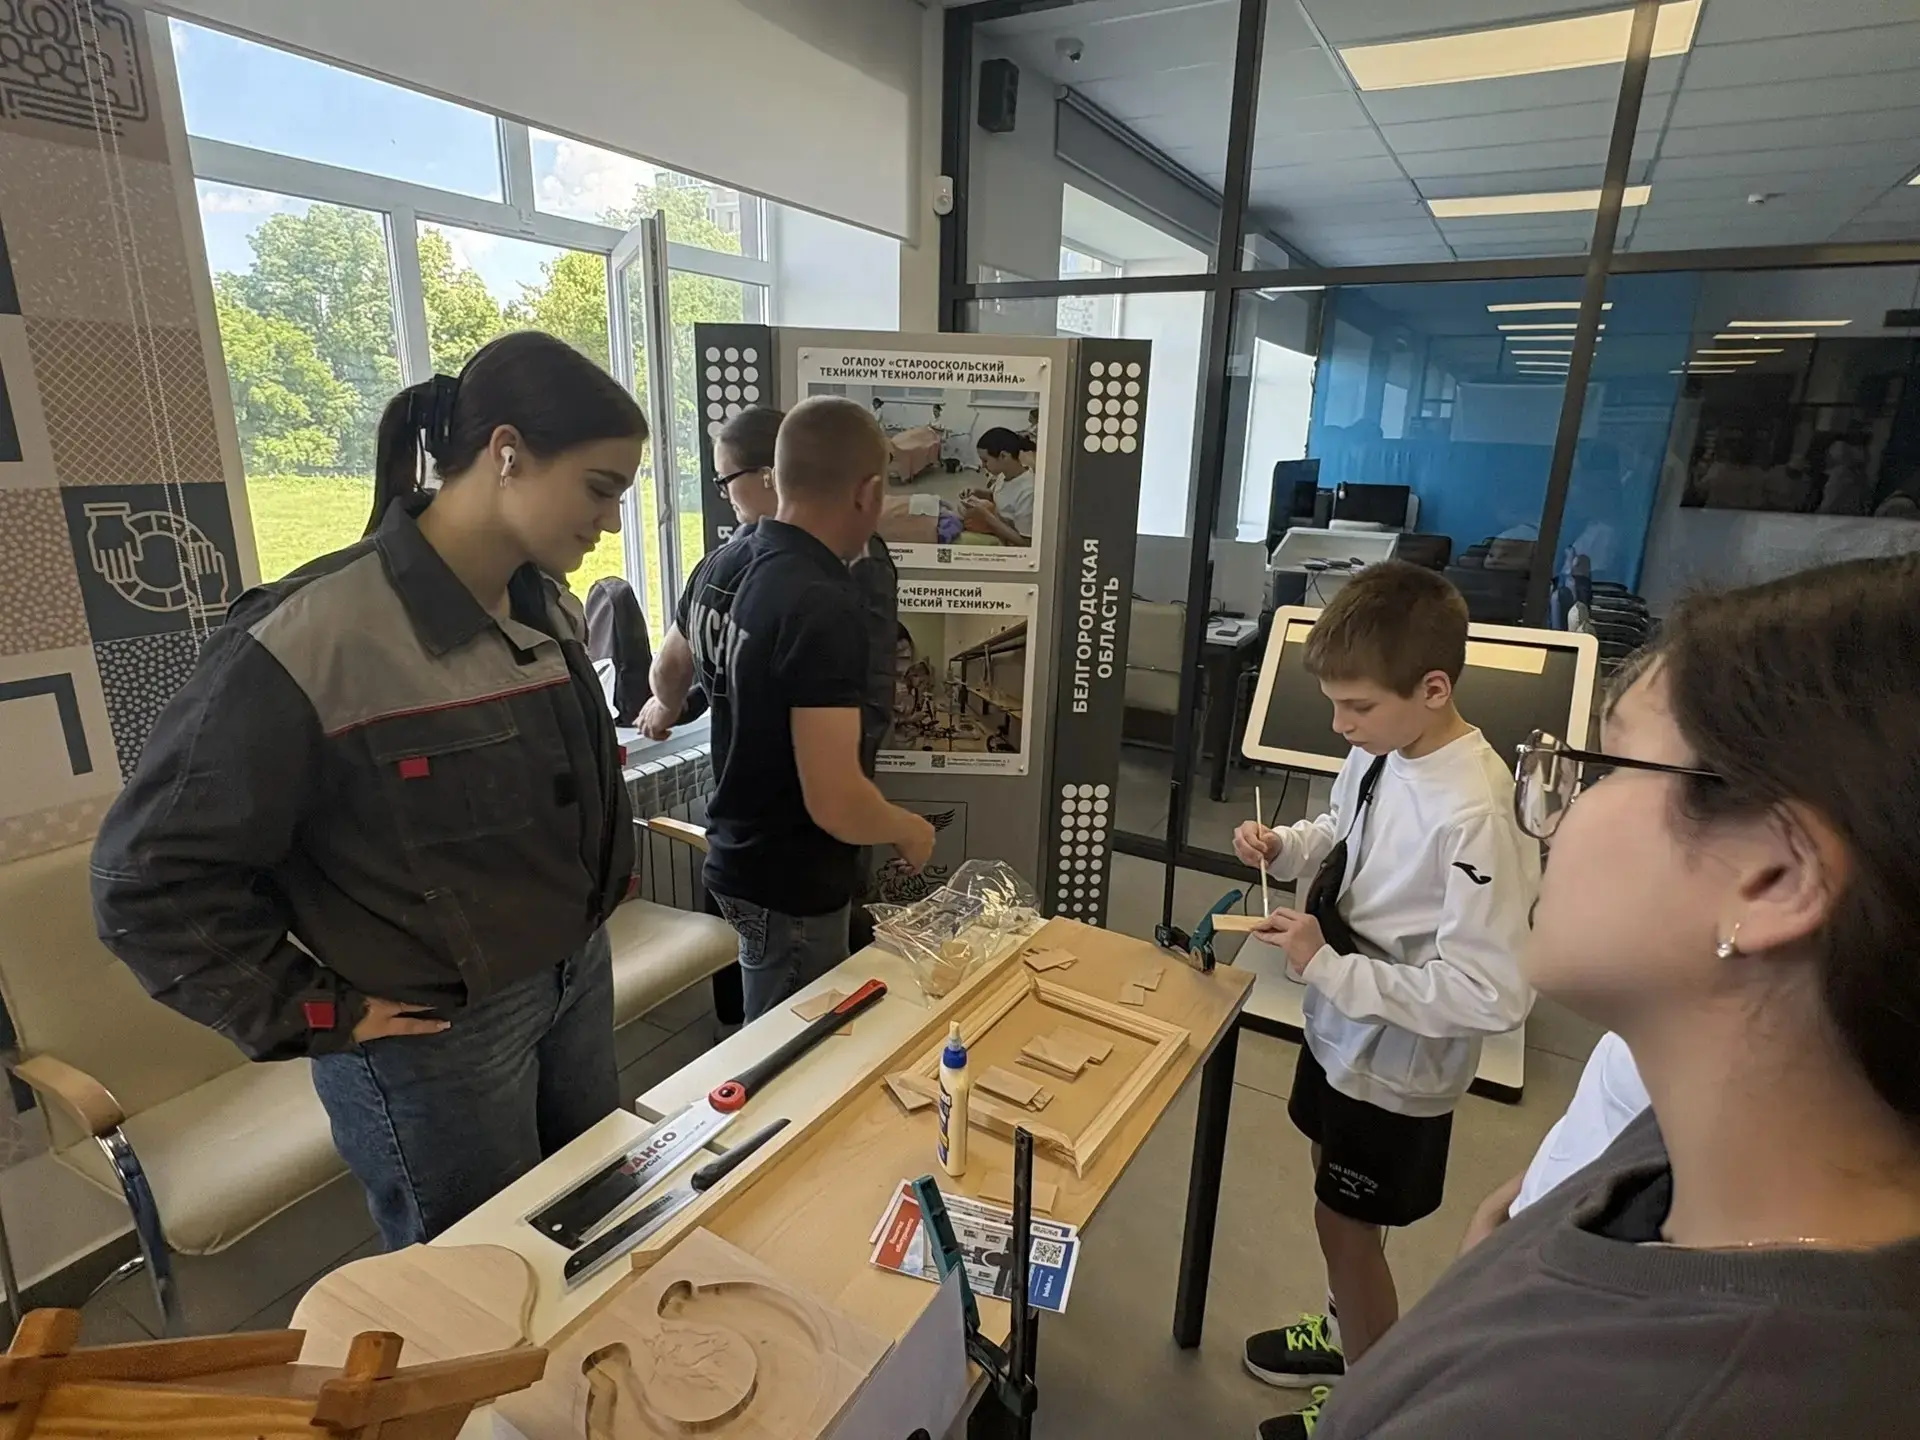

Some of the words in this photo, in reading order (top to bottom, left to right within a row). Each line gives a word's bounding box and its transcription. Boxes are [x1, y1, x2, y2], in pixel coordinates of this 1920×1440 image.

[841, 356, 886, 368] ОГАПОУ
[888, 358, 1005, 372] «СТАРООСКОЛЬСКИЙ
[819, 366, 878, 379] ТЕХНИКУМ
[881, 368, 954, 382] ТЕХНОЛОГИЙ
[957, 371, 965, 382] И
[966, 370, 1026, 385] ДИЗАЙНА»
[902, 586, 982, 598] «ЧЕРНЯНСКИЙ
[898, 596, 943, 608] ЧЕСКИЙ
[946, 599, 1012, 610] ТЕХНИКУМ»
[1072, 539, 1100, 713] БЕЛГОРОДСКАЯ
[1097, 577, 1120, 679] ОБЛАСТЬ
